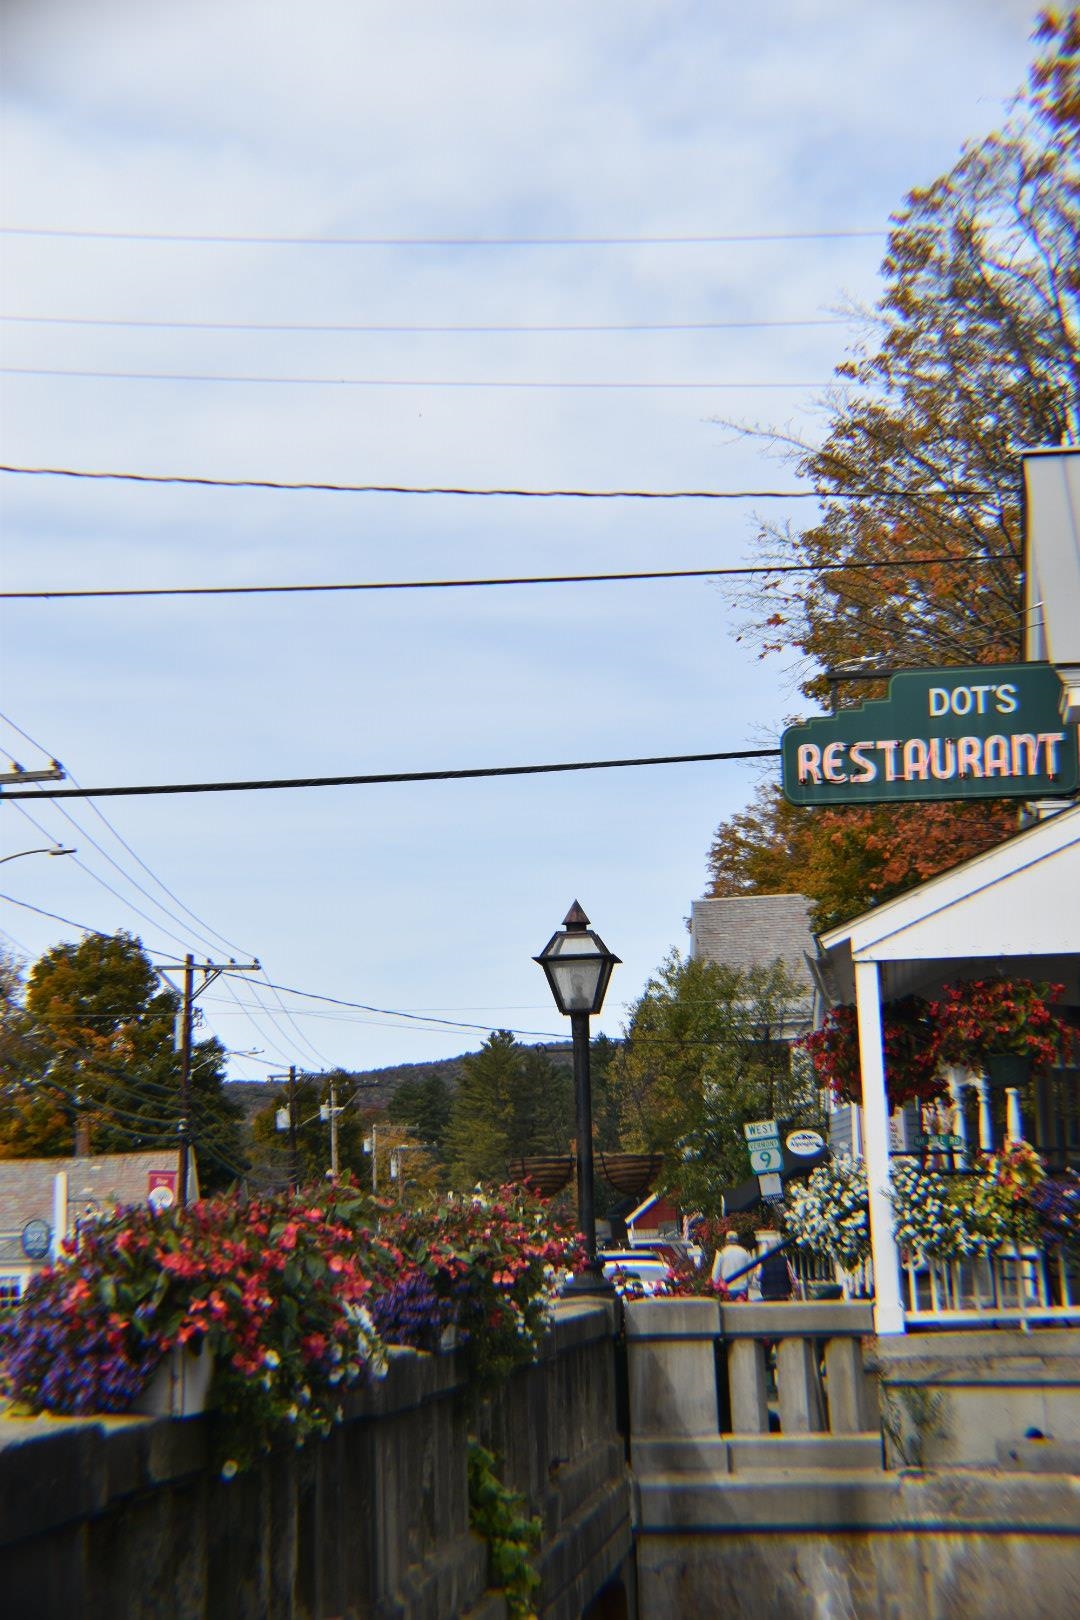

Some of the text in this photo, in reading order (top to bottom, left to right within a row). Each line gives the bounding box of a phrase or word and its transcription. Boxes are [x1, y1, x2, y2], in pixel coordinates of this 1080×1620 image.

[929, 684, 1018, 717] DOT'S
[797, 732, 1065, 785] RESTAURANT
[748, 1123, 773, 1135] WEST
[760, 1151, 772, 1168] 9
